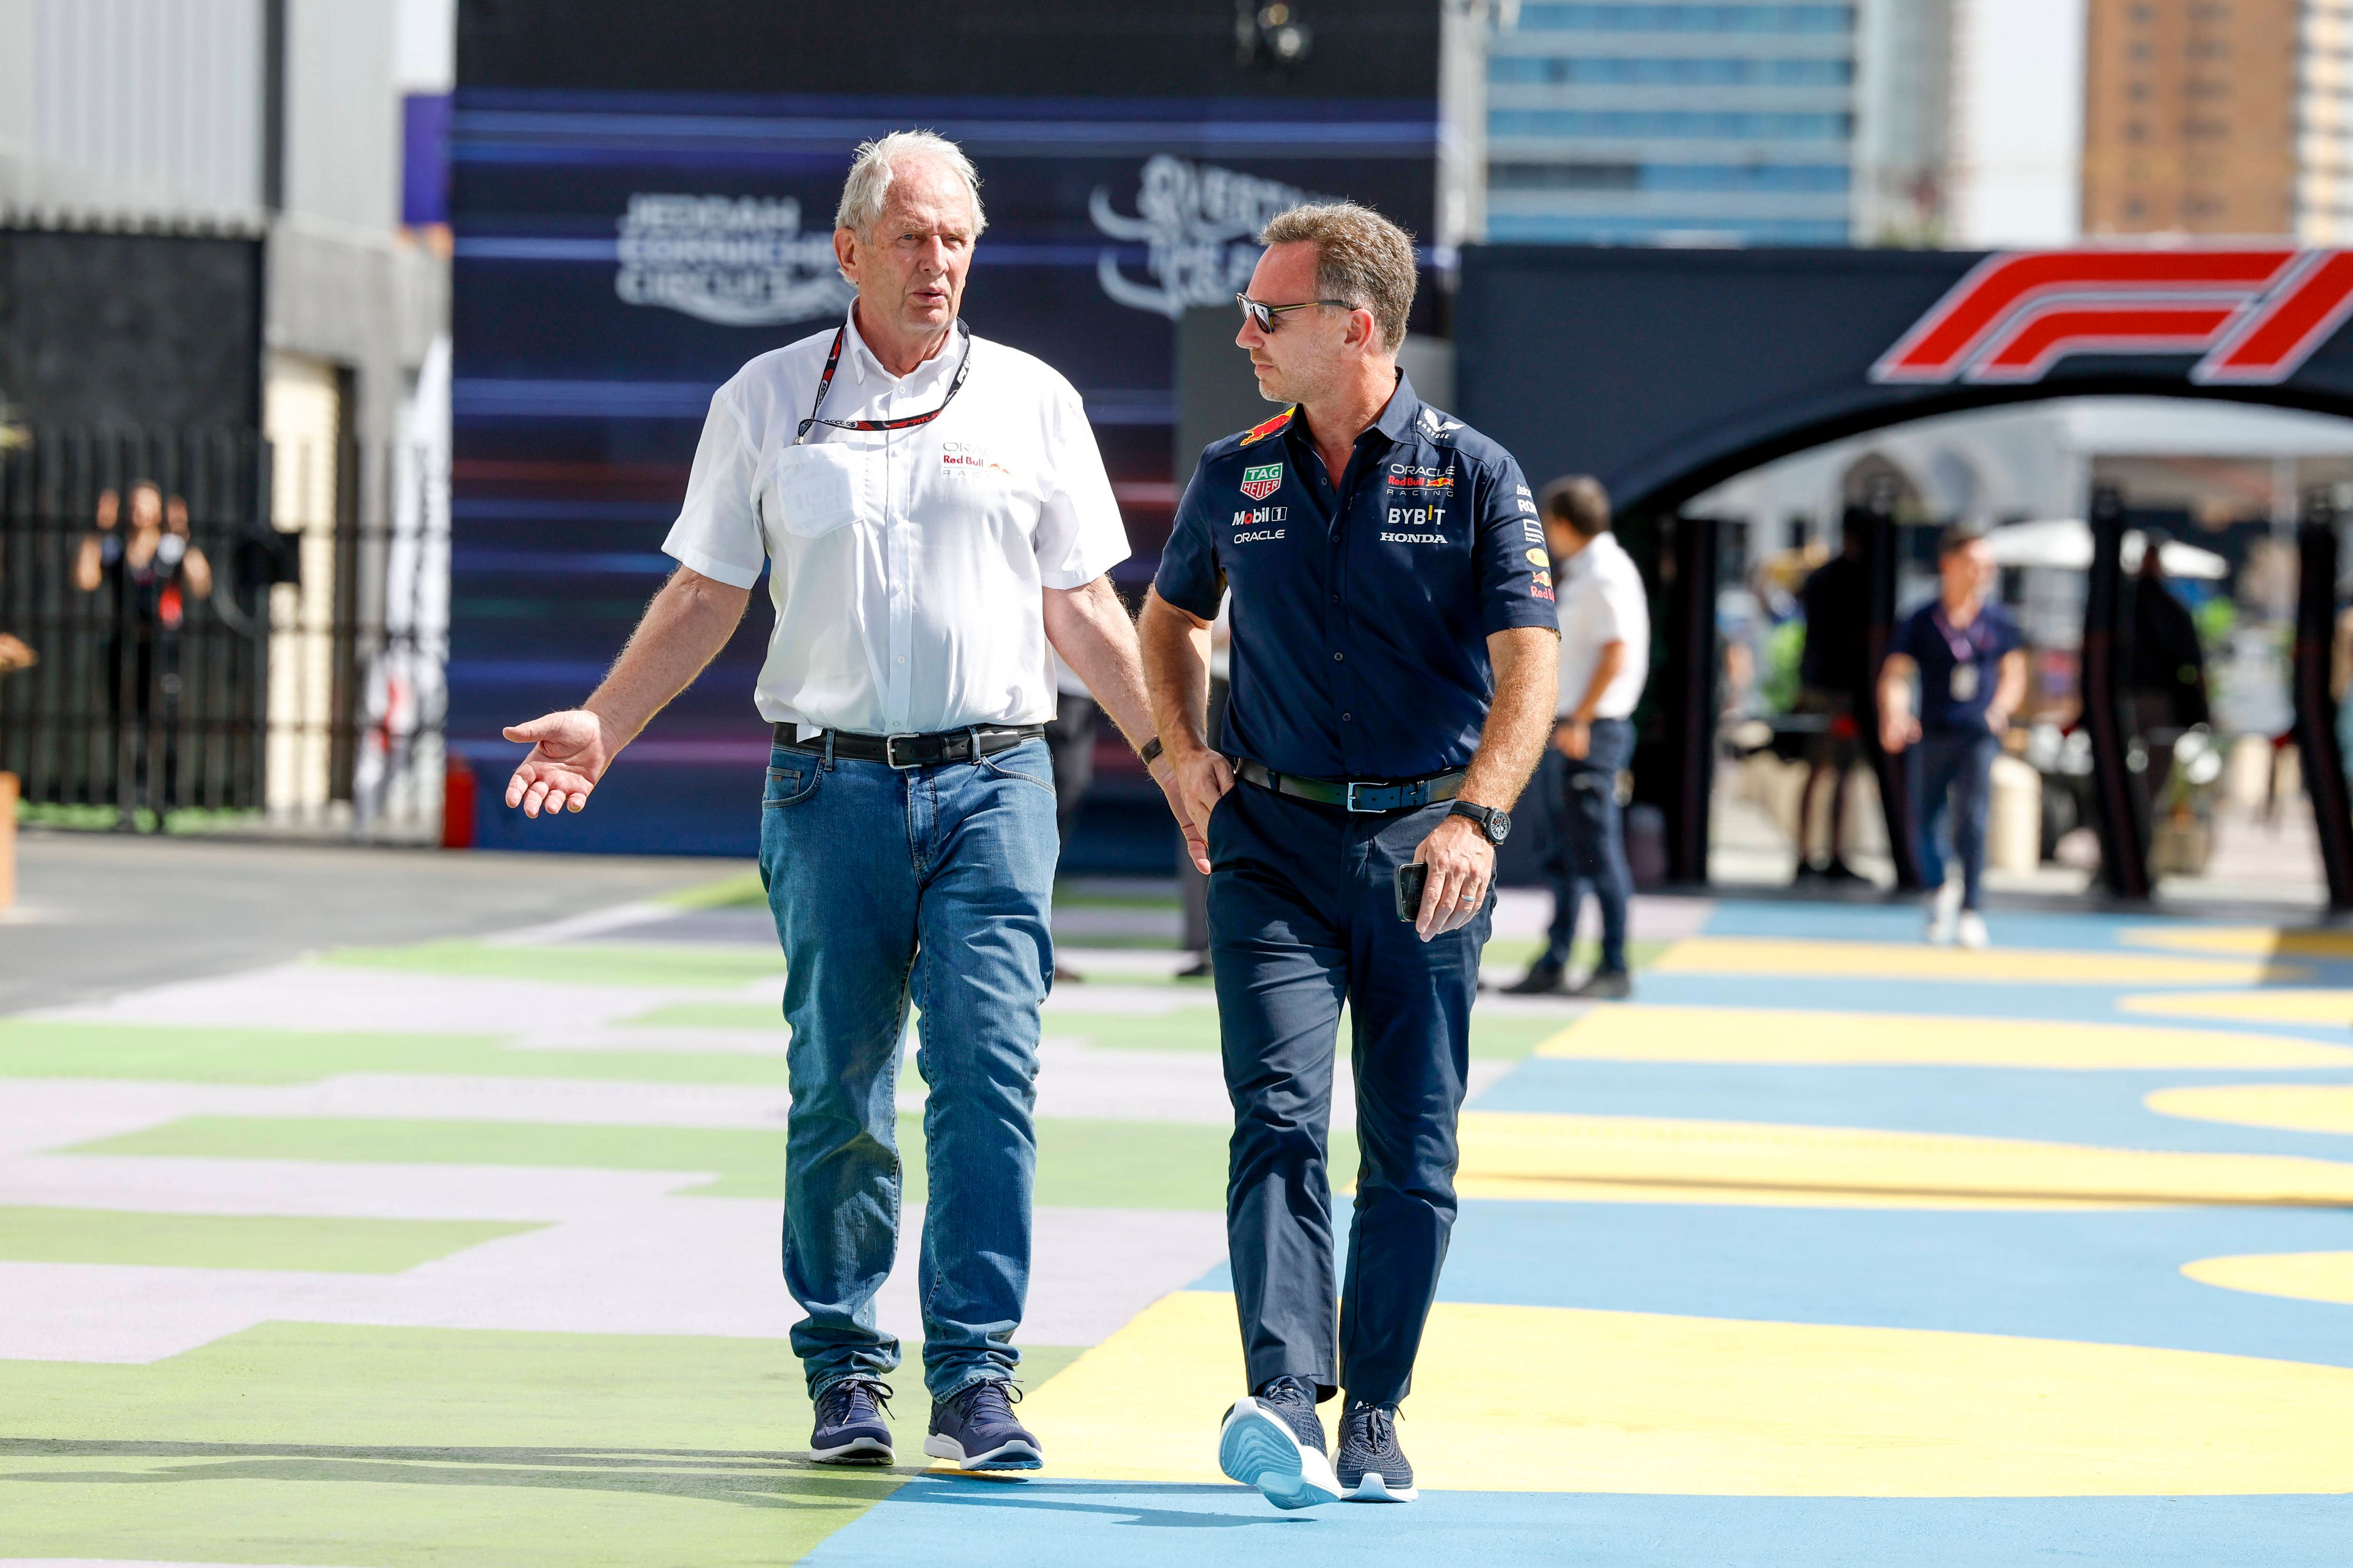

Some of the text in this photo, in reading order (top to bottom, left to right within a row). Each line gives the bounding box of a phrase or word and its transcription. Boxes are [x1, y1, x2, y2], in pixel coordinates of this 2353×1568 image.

[1869, 251, 2353, 385] F1
[824, 419, 856, 428] ACCESS
[1417, 420, 1450, 439] CASTORE
[944, 455, 983, 467] Red Bull
[1248, 466, 1279, 480] TAG
[1390, 463, 1455, 477] ORACLE
[1388, 475, 1425, 486] Red Bull
[1244, 481, 1278, 498] HEUER
[1387, 489, 1454, 497] RACING
[1232, 507, 1269, 526] Mobil
[1388, 505, 1446, 525] BYBIT
[1234, 529, 1285, 544] ORACLE
[1380, 532, 1448, 543] HONDA
[1531, 586, 1548, 599] Red
